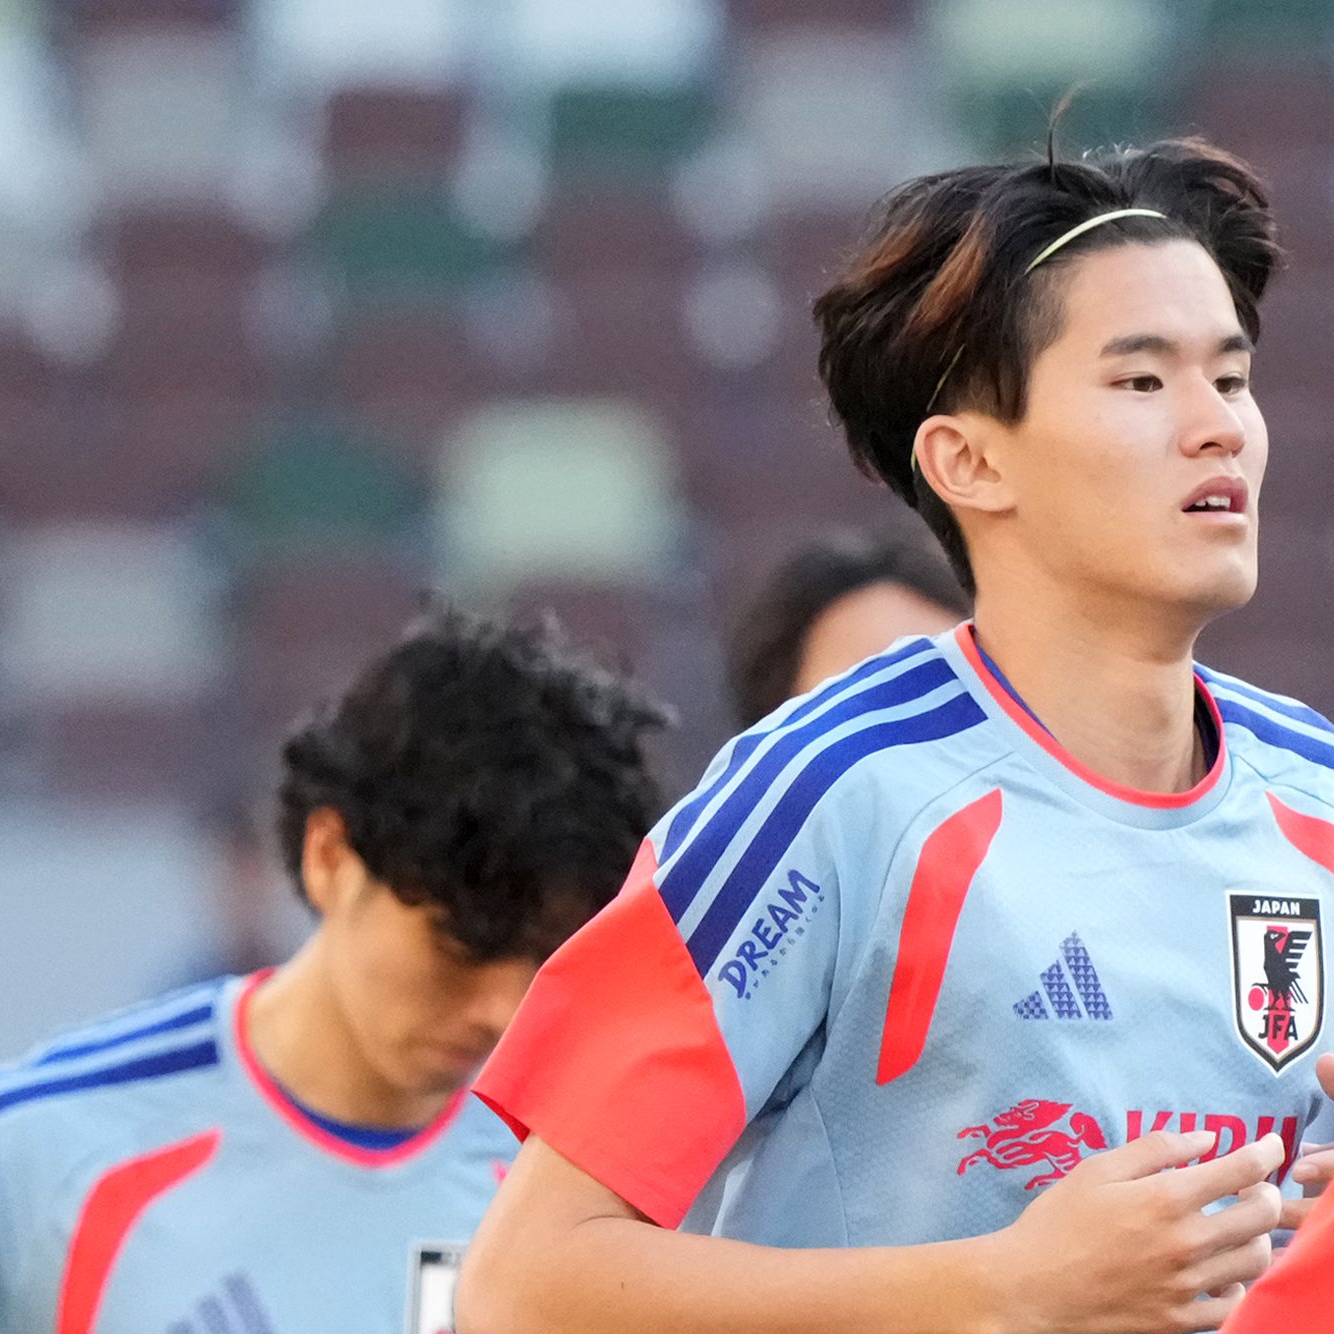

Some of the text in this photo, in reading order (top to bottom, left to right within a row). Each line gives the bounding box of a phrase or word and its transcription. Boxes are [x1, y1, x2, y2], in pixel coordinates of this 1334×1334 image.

[1252, 900, 1300, 915] JAPAN
[718, 869, 820, 998] DREAM
[1258, 1014, 1298, 1040] JFA
